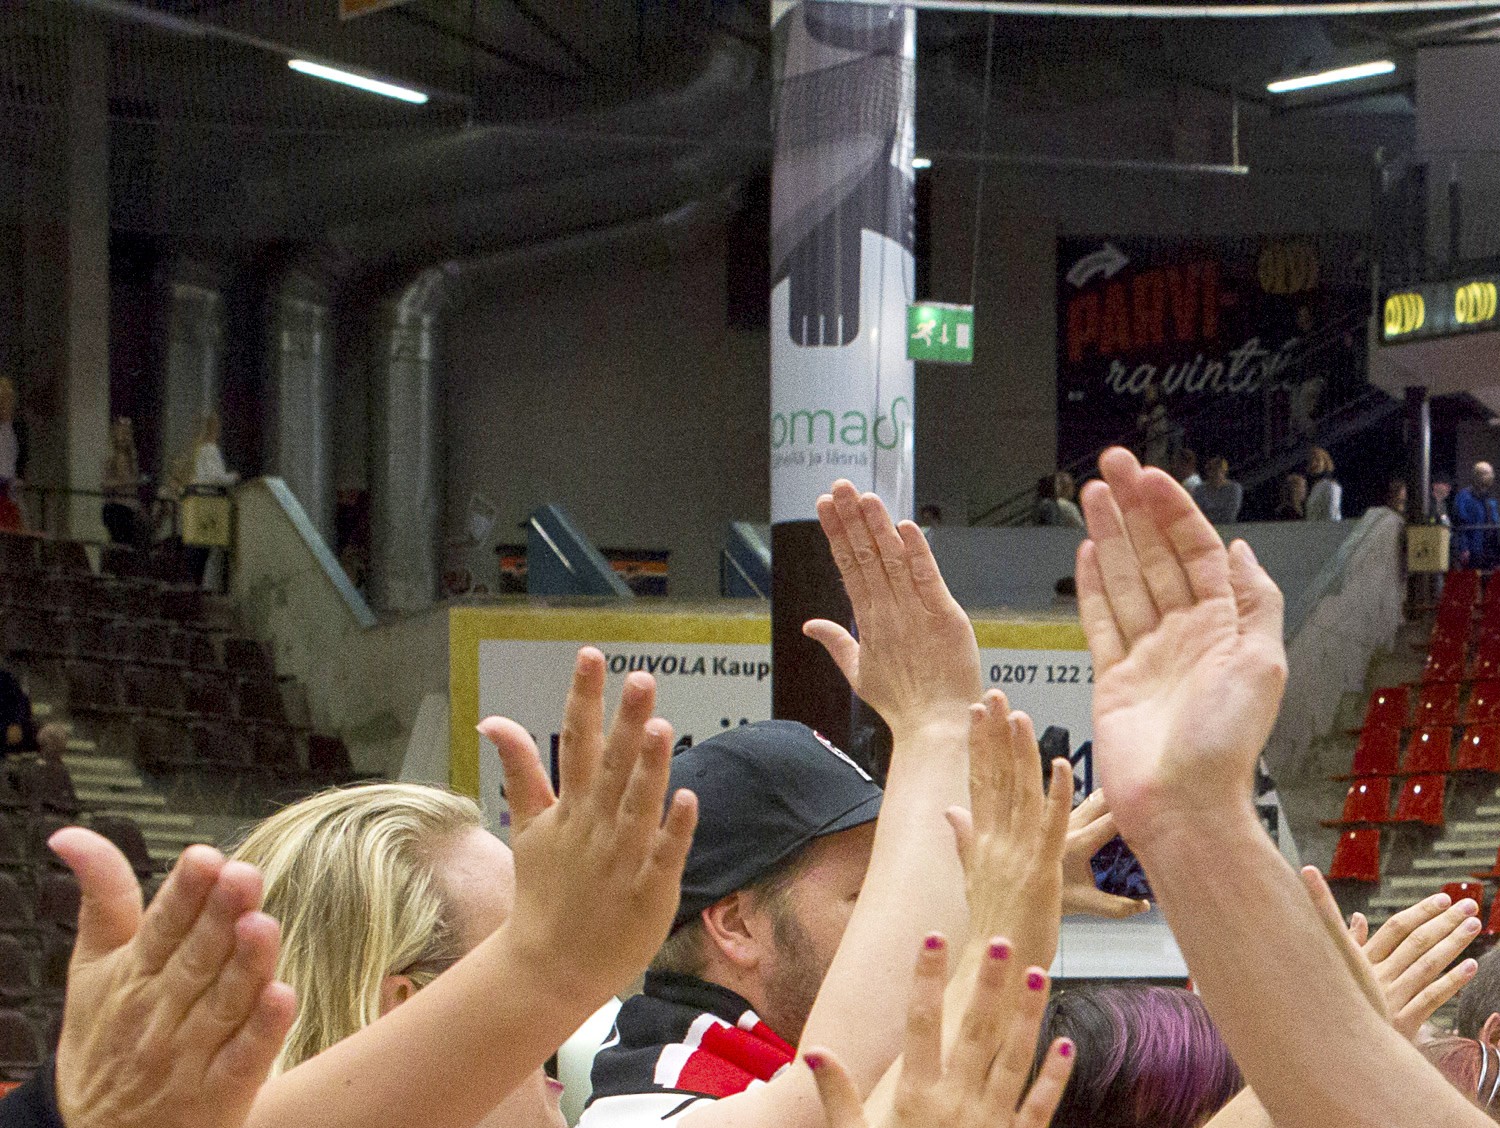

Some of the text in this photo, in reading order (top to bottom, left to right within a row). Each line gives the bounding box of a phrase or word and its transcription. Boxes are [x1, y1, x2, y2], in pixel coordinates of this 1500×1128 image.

[606, 654, 705, 676] OUVOLA
[712, 658, 770, 681] Kaup
[990, 664, 1037, 684] 0207
[1047, 664, 1080, 684] 122
